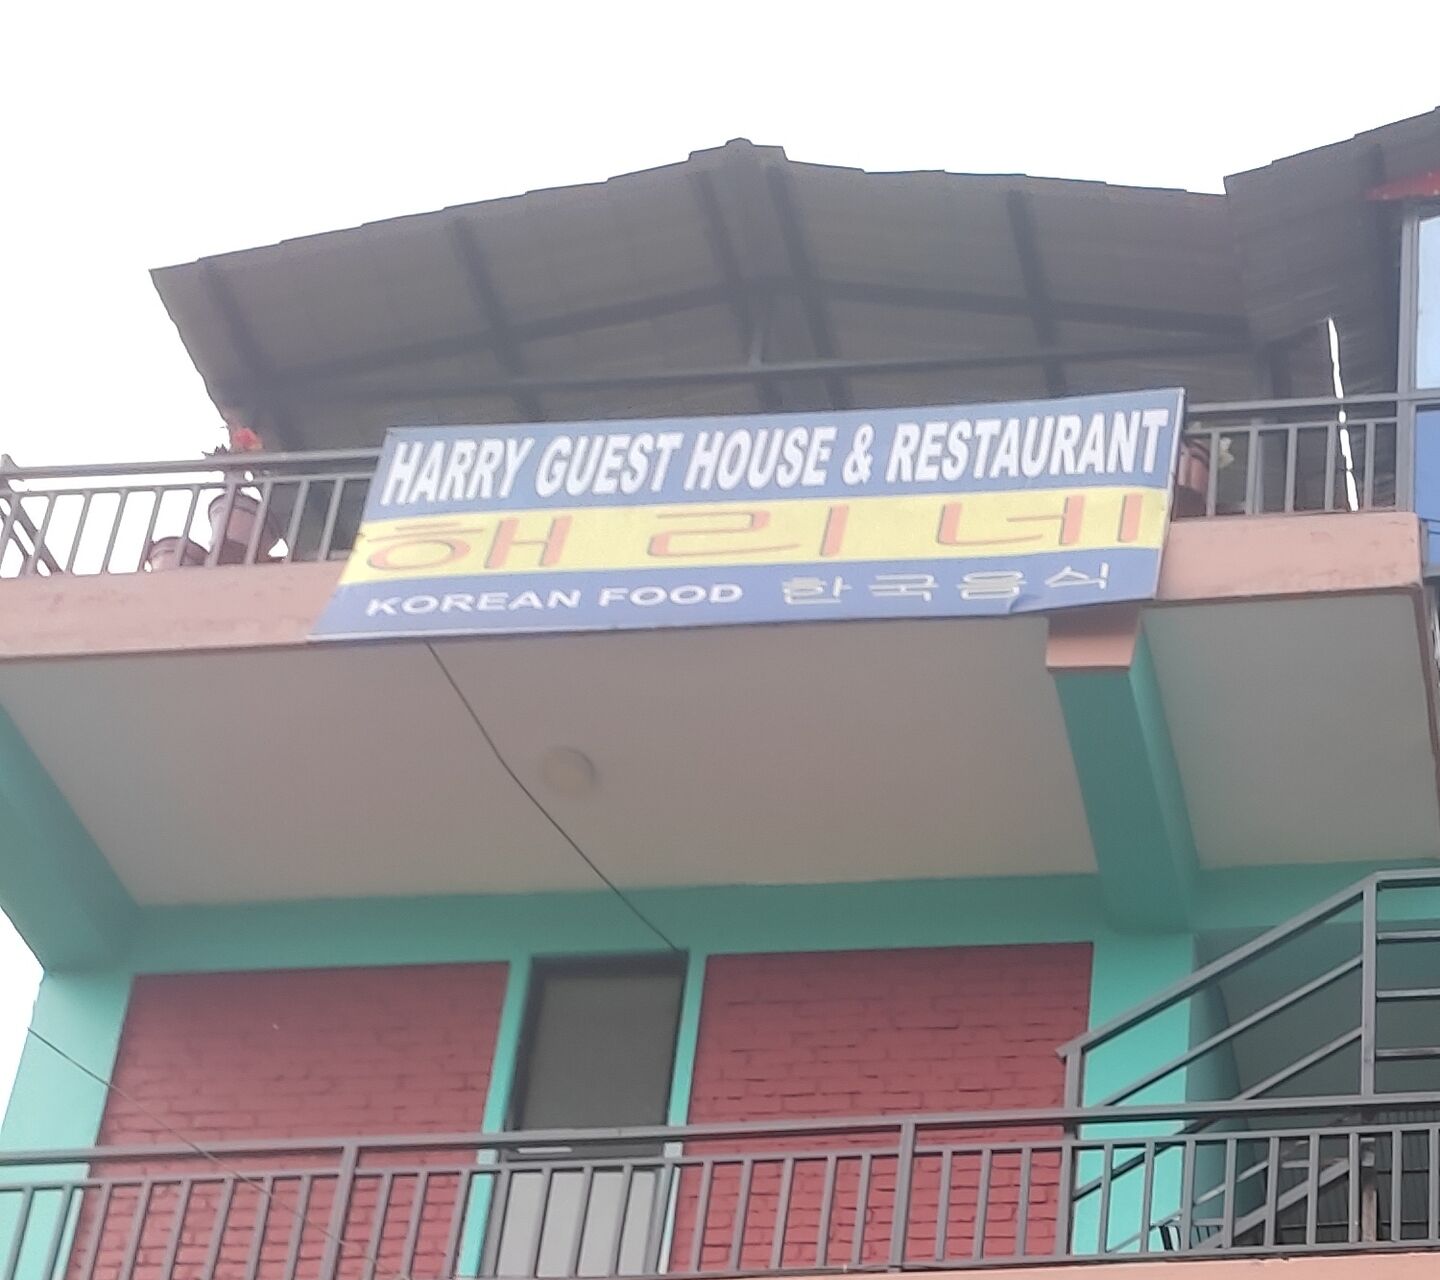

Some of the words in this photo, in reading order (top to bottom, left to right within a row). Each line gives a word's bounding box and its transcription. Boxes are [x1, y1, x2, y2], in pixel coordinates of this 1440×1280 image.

[380, 439, 535, 507] HARRY
[537, 432, 683, 496] GUEST
[685, 424, 838, 492] HOUSE
[841, 422, 875, 486] &
[885, 409, 1170, 484] RESTAURANT
[365, 588, 583, 618] KOREAN
[598, 582, 744, 608] FOOD
[781, 562, 1110, 606] 한국음식
